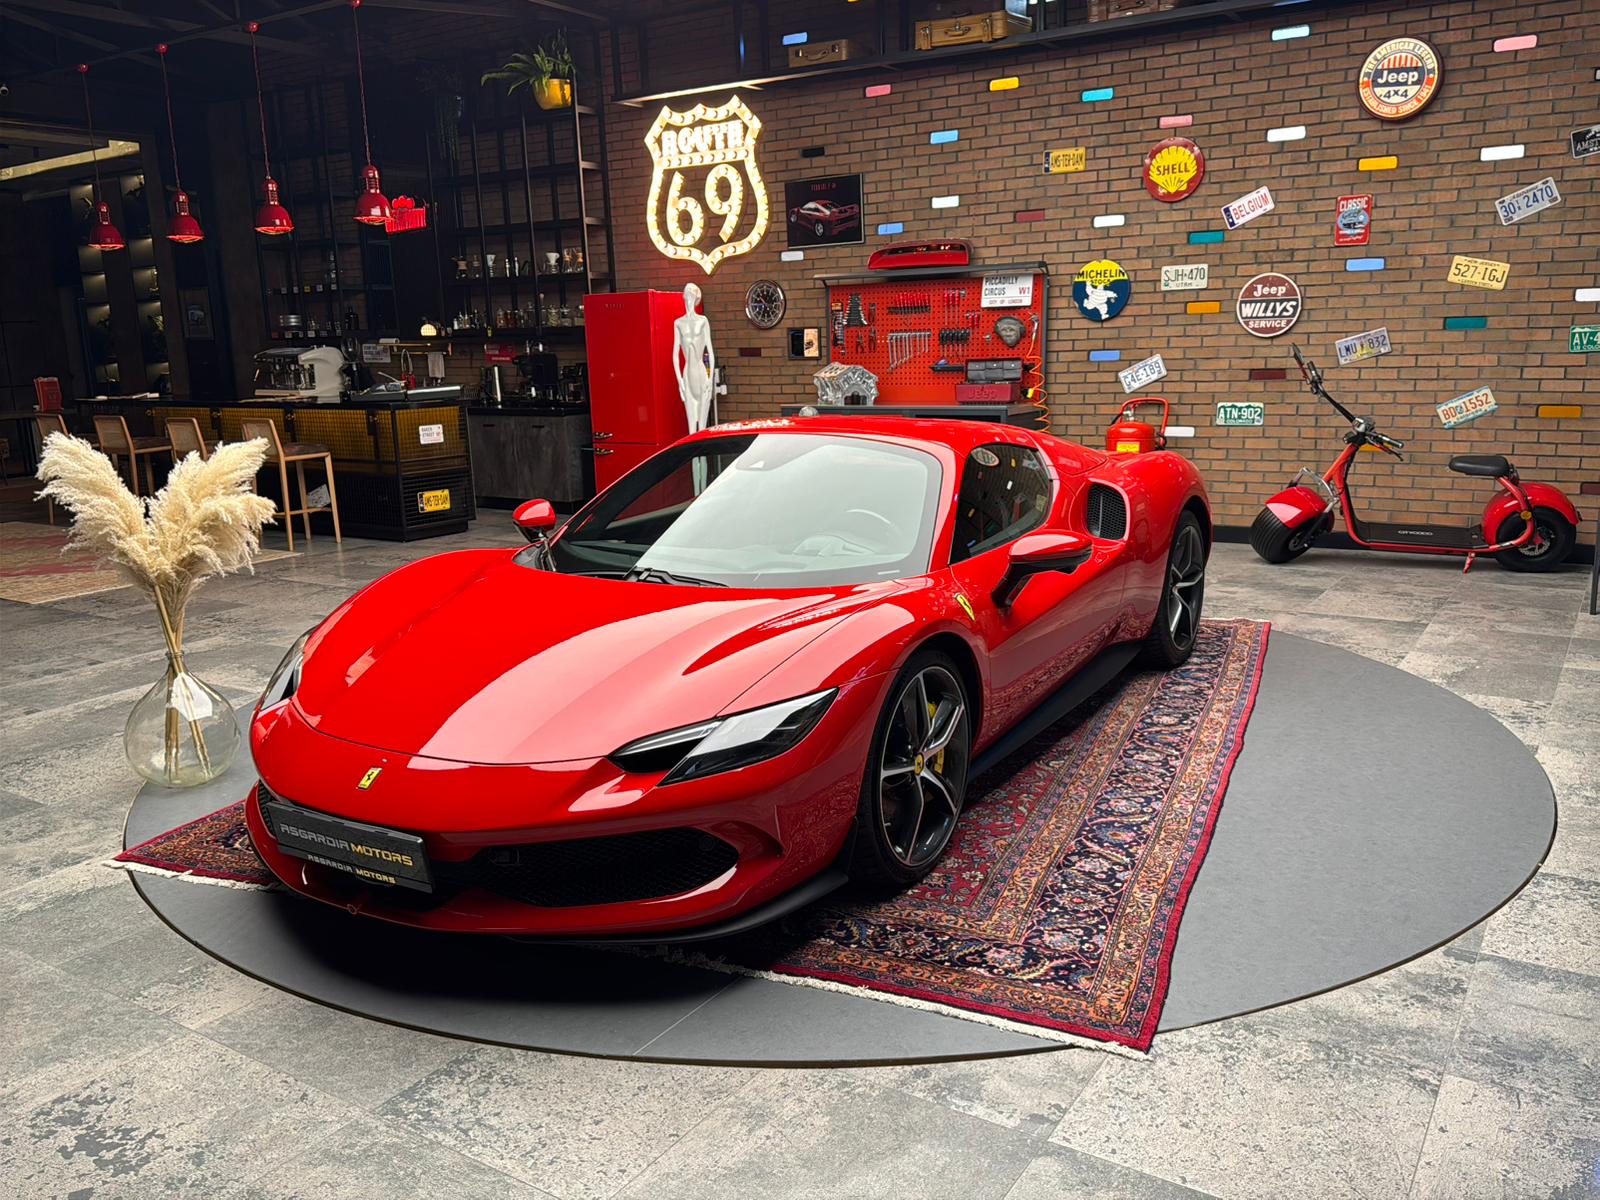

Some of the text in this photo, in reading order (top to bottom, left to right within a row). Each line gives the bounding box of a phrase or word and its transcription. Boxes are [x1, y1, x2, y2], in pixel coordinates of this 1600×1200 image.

[1376, 41, 1415, 60] AMERICAN
[1414, 44, 1434, 69] LEGEND
[1377, 70, 1418, 85] Jeep
[661, 119, 744, 157] ROUTE
[1155, 162, 1190, 176] SHELL
[666, 163, 744, 247] 69
[1232, 192, 1270, 220] BELGIUM
[1500, 201, 1517, 218] 30
[1523, 185, 1554, 209] 2470
[985, 275, 1018, 286] PICCADILLY
[1077, 268, 1125, 280] MICHELIN
[984, 286, 1031, 297] CIRCUS W1
[1253, 284, 1288, 297] Jeep
[1241, 301, 1297, 318] WILLYS
[1248, 319, 1287, 329] SERVICE
[1367, 334, 1388, 350] 832
[1463, 392, 1492, 413] 1552
[279, 823, 413, 866] ASGARDIA MOTORS
[307, 854, 397, 884] ASGARDIA MOTORS
